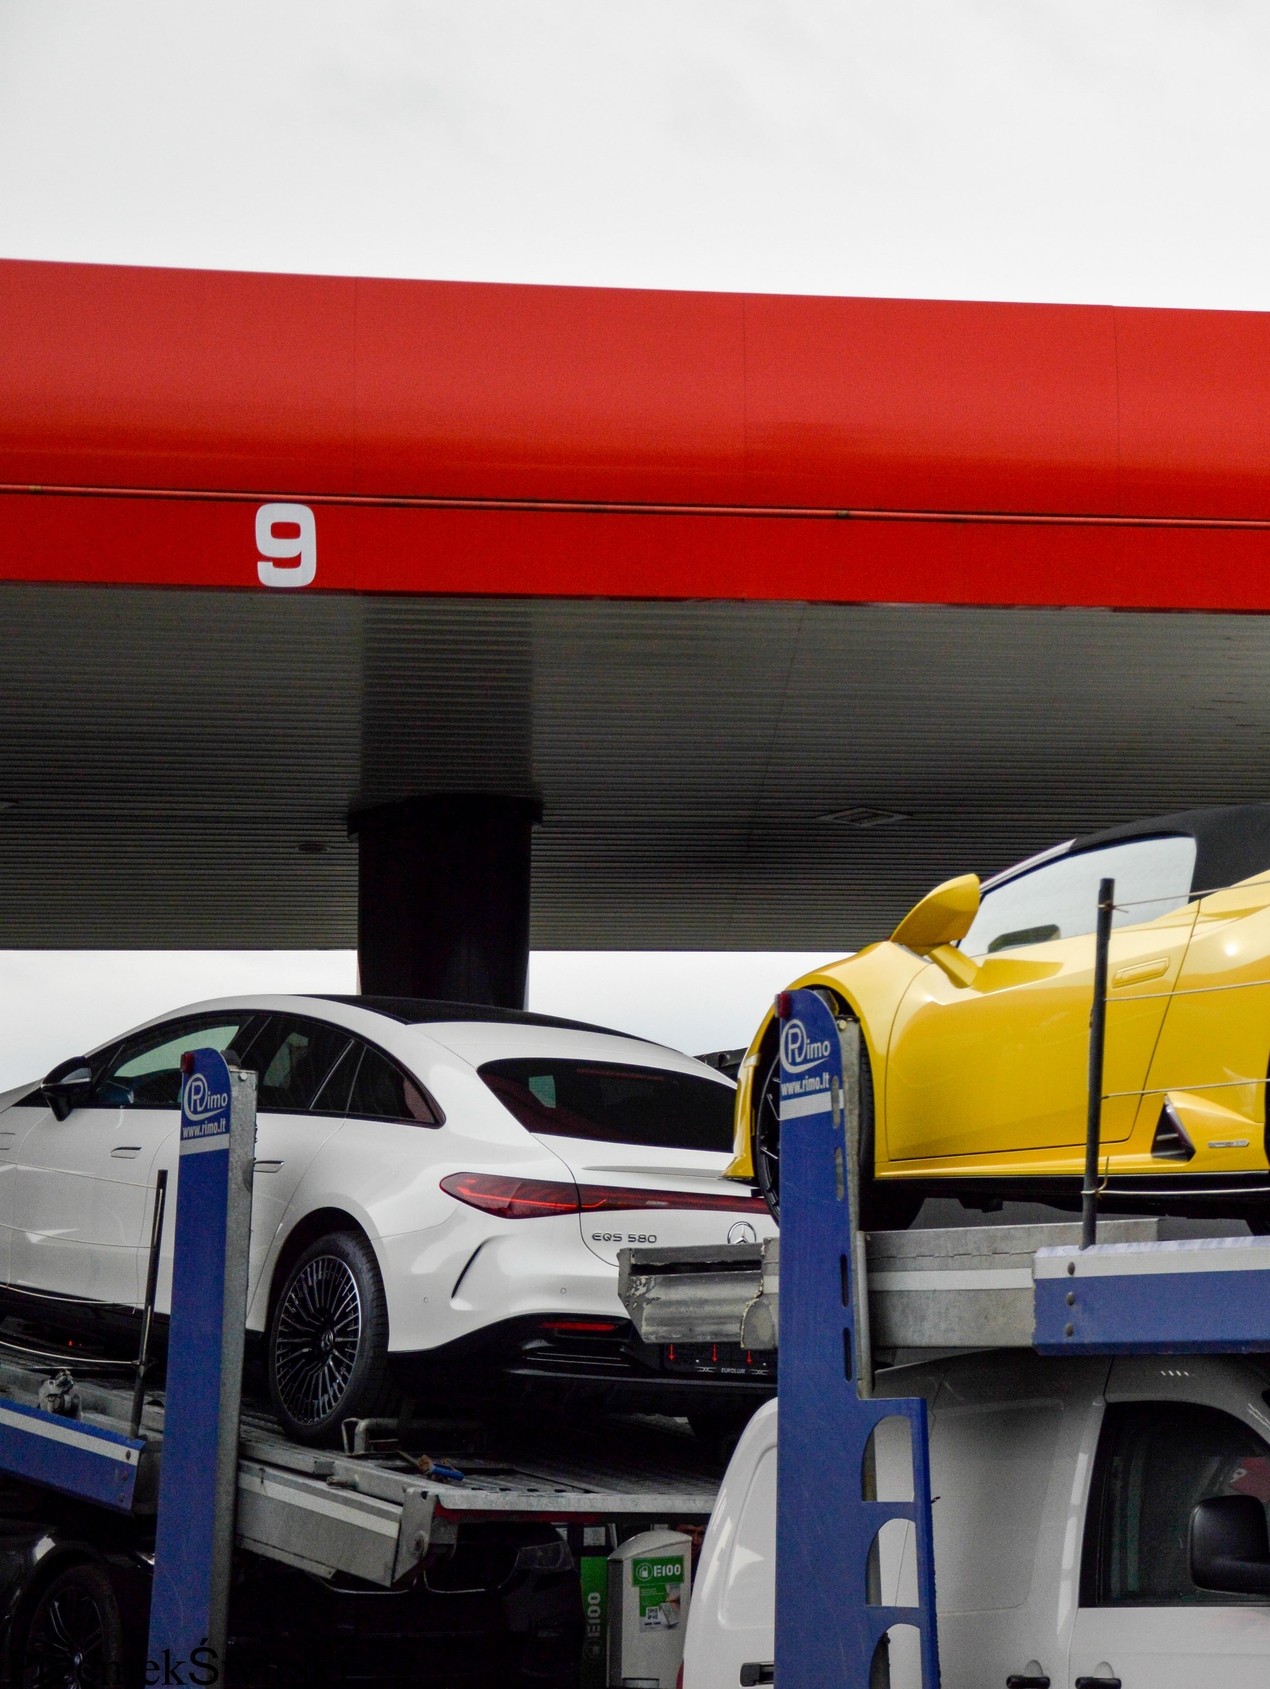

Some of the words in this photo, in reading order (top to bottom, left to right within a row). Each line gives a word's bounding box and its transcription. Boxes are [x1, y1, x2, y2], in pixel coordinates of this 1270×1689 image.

[255, 503, 317, 588] 9
[783, 1022, 831, 1067] Rimo
[187, 1076, 228, 1114] Rimo
[781, 1072, 830, 1096] www.rimo.lt
[182, 1118, 227, 1138] www.rimo.lt
[592, 1232, 622, 1242] EQS
[627, 1233, 657, 1243] 580
[653, 1564, 681, 1578] E100
[587, 1592, 601, 1637] E100
